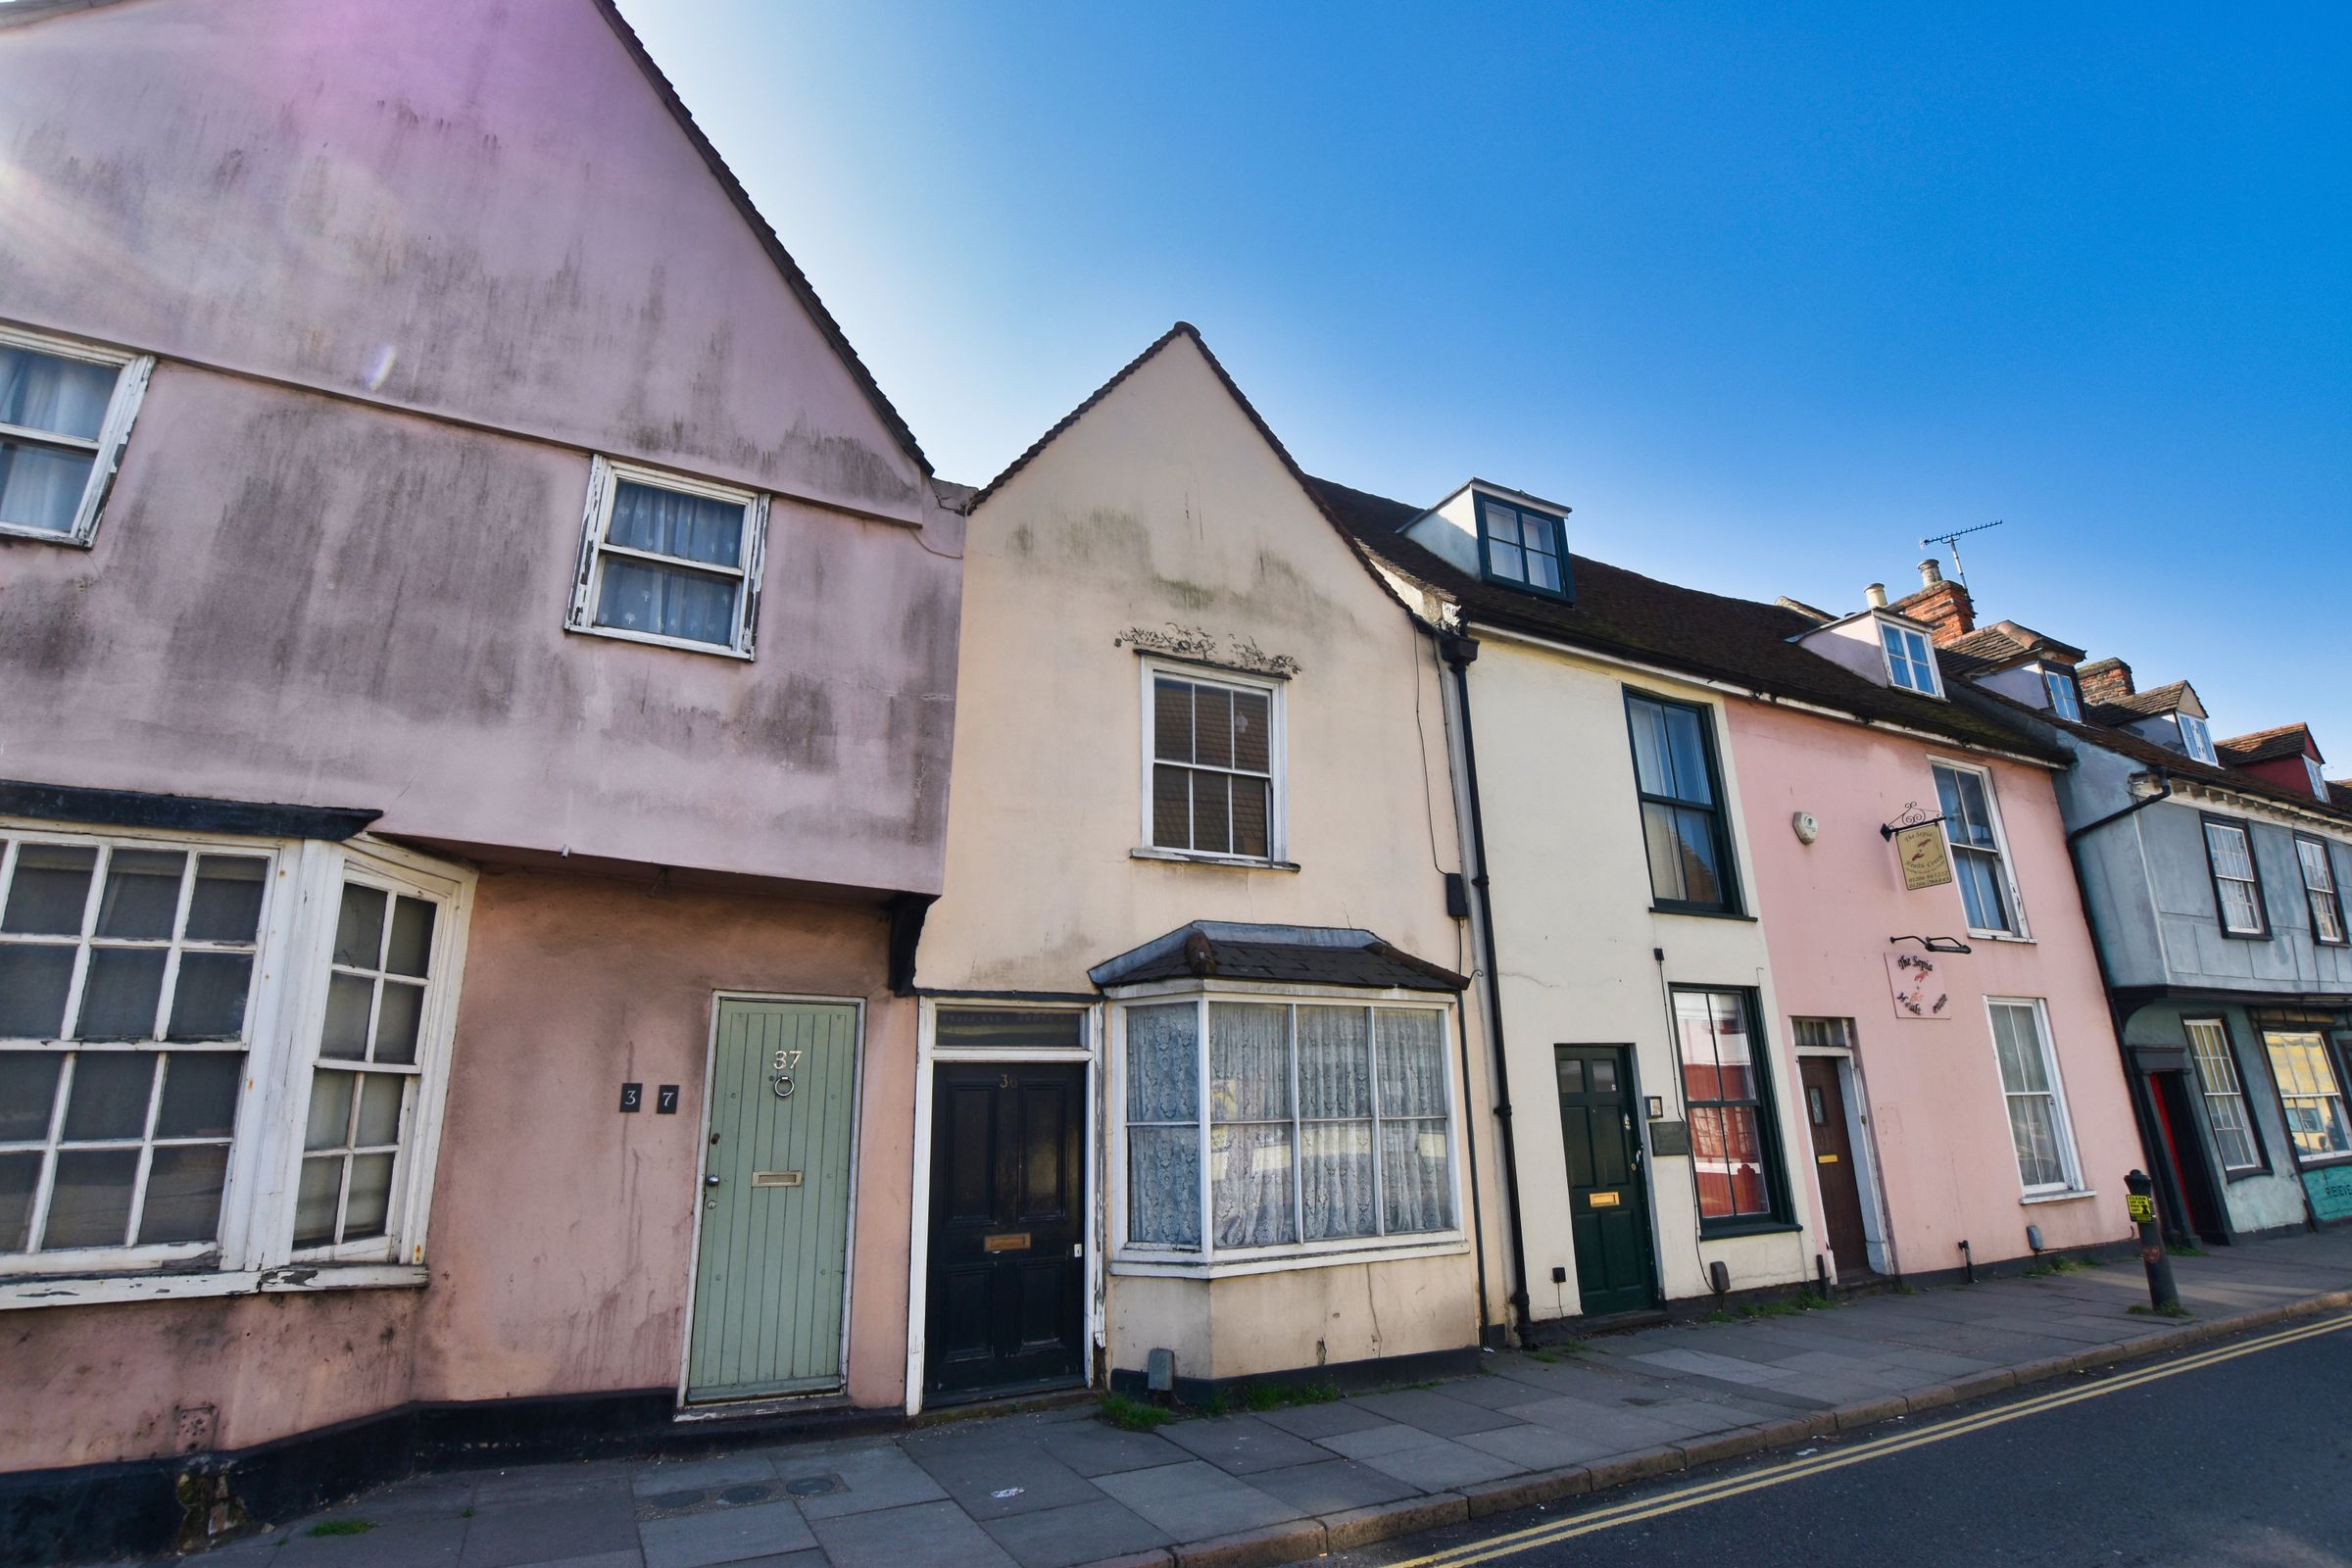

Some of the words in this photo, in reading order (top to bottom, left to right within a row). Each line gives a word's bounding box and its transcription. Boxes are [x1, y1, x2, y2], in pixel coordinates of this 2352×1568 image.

[1897, 955, 1911, 970] The
[1912, 956, 1934, 971] Sepia
[772, 1051, 803, 1069] 37
[624, 1090, 636, 1105] 3
[662, 1092, 674, 1106] 7
